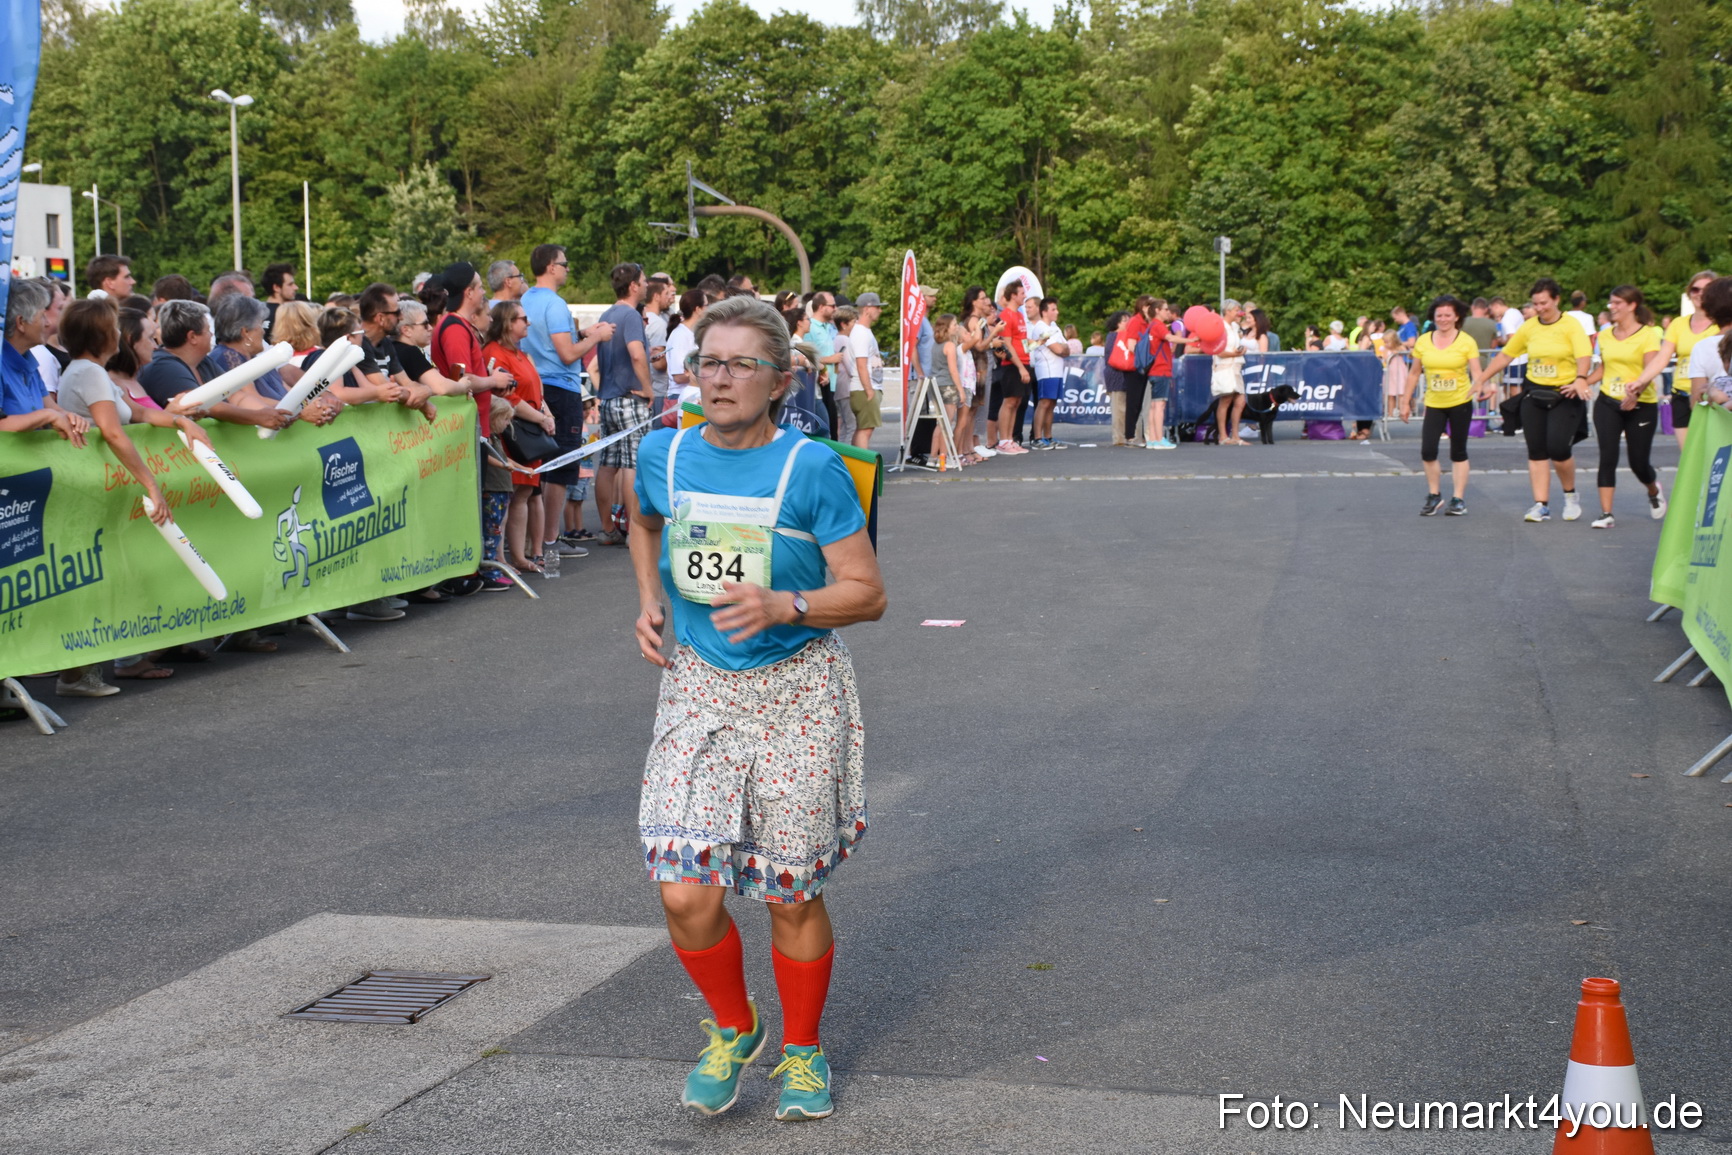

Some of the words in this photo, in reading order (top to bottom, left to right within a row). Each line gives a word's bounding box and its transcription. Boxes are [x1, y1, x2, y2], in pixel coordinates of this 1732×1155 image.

[1278, 401, 1335, 412] OMOBILE
[330, 461, 359, 481] Fischer
[310, 485, 408, 562] firmenlauf
[316, 551, 360, 580] neumarkt
[687, 551, 745, 582] 834
[61, 590, 247, 651] www.firmenlauf-oberpfalz.de
